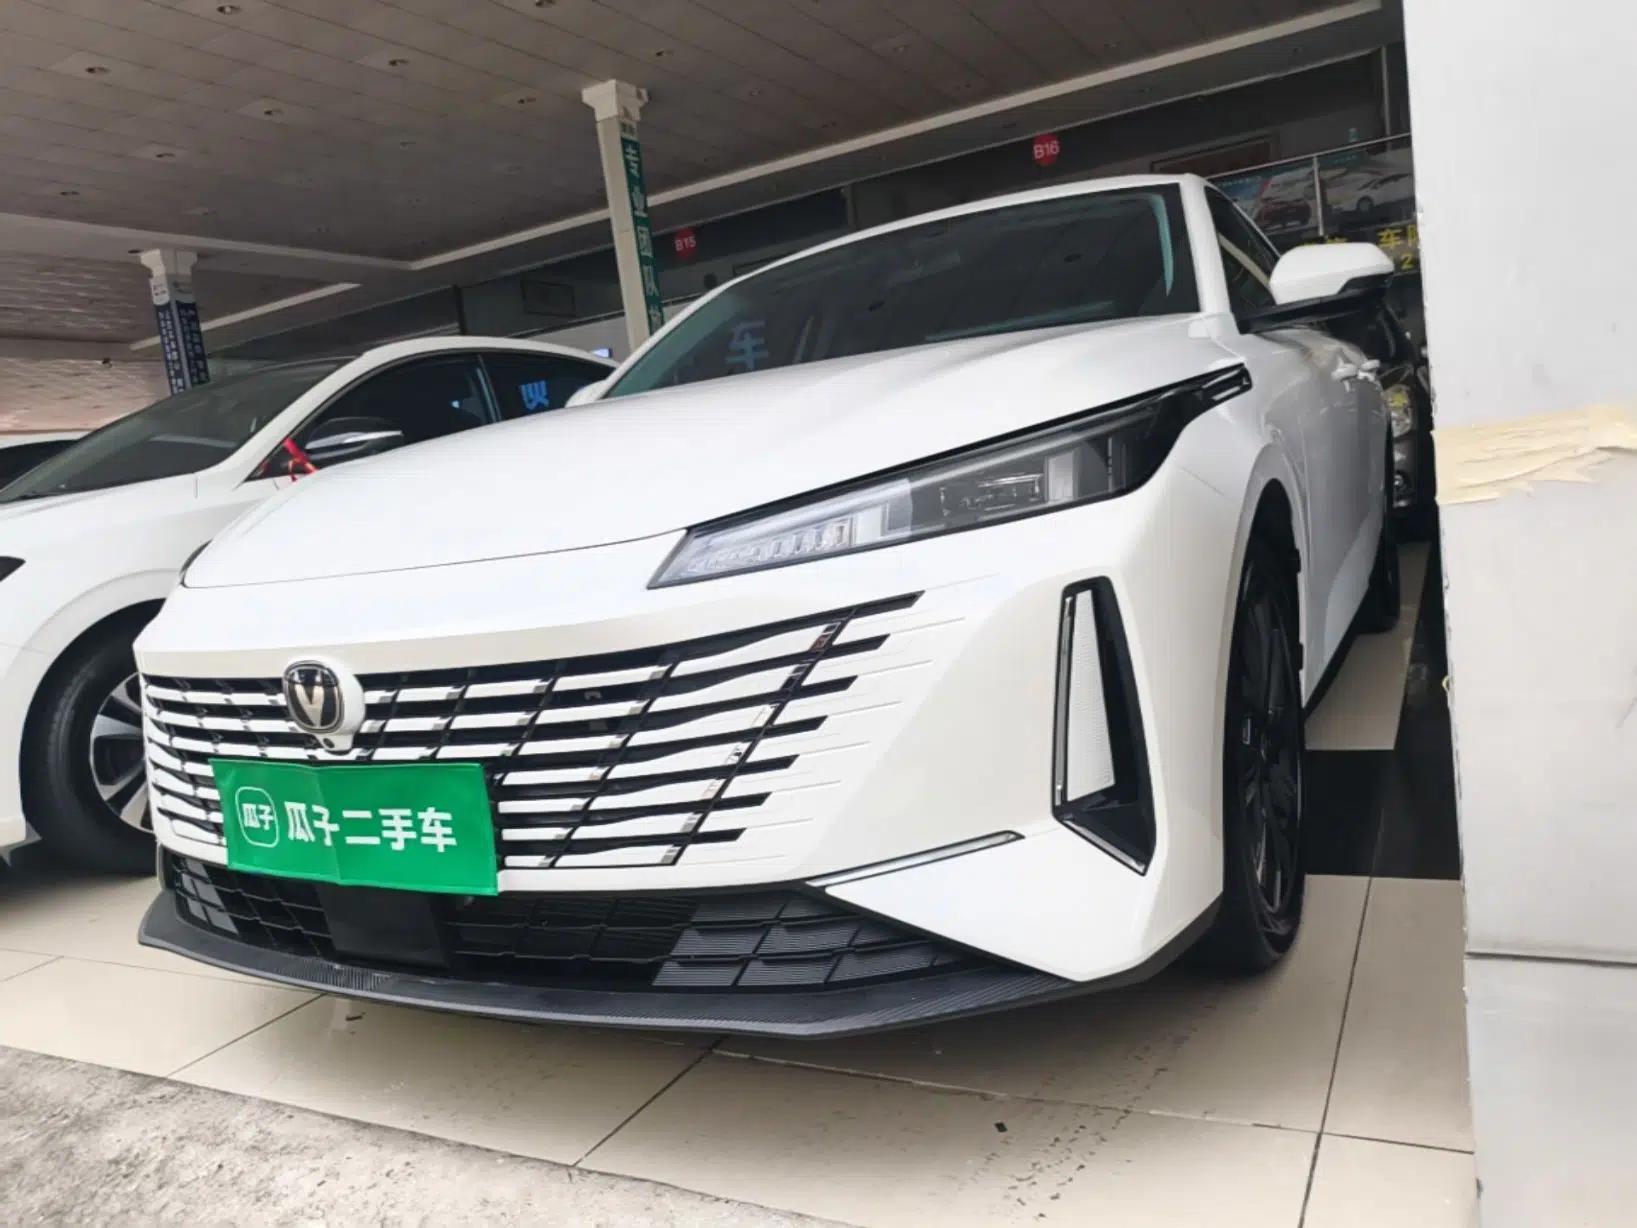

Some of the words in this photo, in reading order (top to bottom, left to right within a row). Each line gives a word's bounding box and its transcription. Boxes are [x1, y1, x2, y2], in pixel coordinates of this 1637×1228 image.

[1033, 140, 1060, 159] B16
[675, 236, 697, 252] B15
[242, 804, 274, 830] 瓜子
[284, 801, 457, 852] 瓜子二手车
